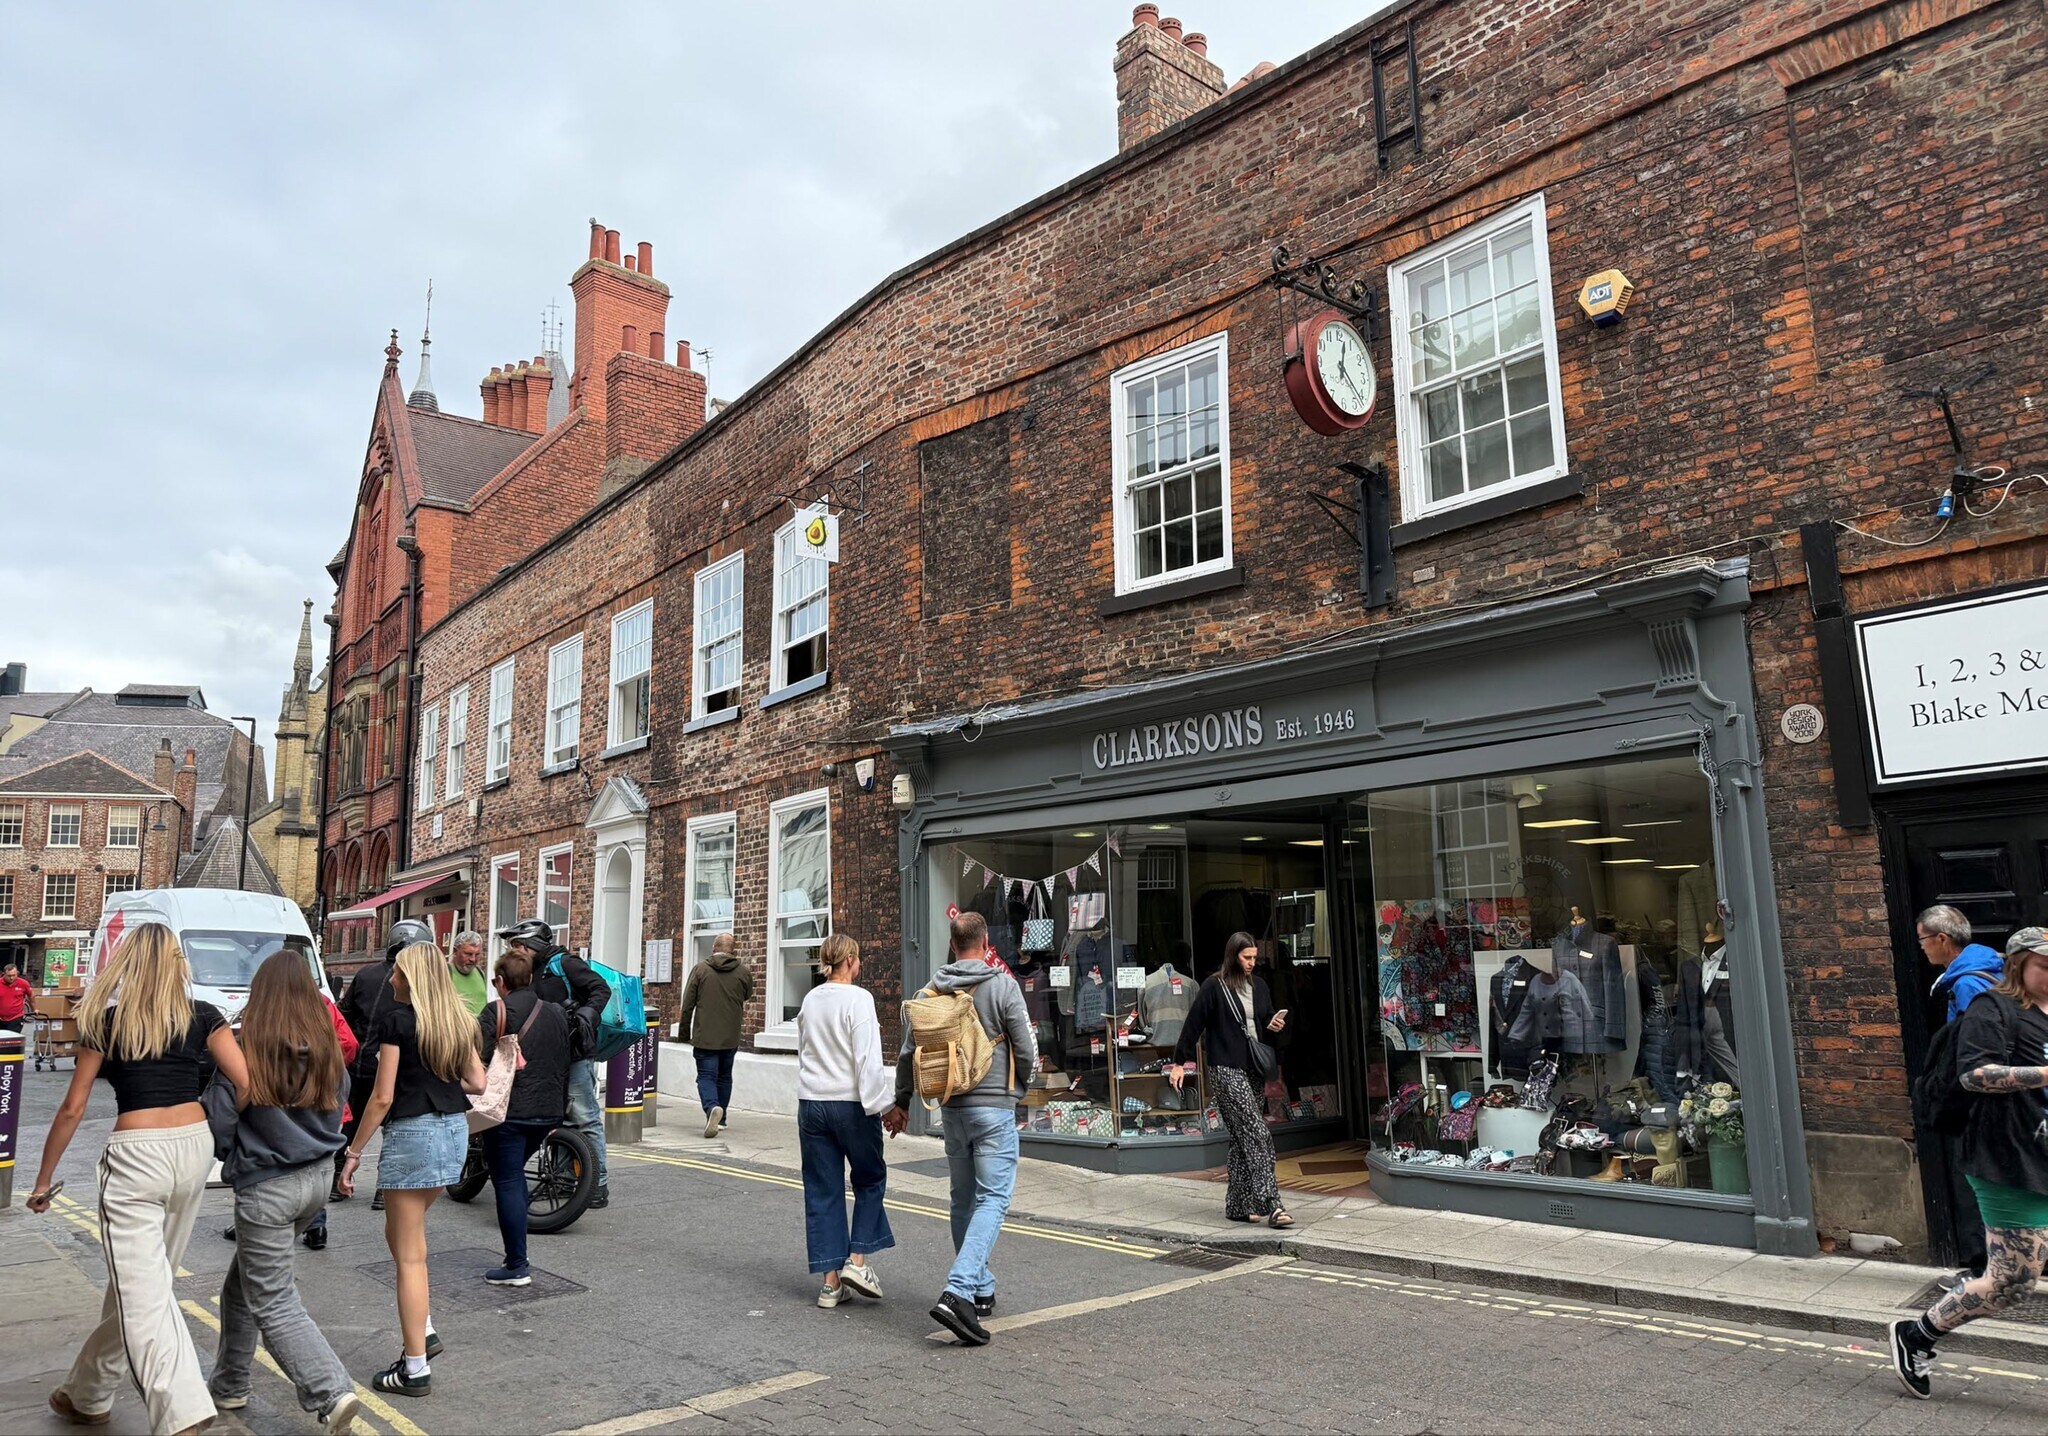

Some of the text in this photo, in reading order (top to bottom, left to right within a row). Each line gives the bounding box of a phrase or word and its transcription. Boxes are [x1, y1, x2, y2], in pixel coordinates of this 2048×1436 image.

[1589, 285, 1612, 301] ADT
[1950, 659, 1977, 683] 2,
[1989, 652, 2006, 676] 3
[2020, 649, 2046, 671] &
[1787, 715, 1816, 726] DESIGN
[1789, 709, 1813, 718] YORK
[1909, 699, 1988, 728] Blake
[1092, 705, 1356, 770] CLARKSONS Est. 1946
[1788, 722, 1817, 732] AWARD
[1500, 854, 1571, 879] YORKSHIRE
[0, 1064, 14, 1114] Enjoy York
